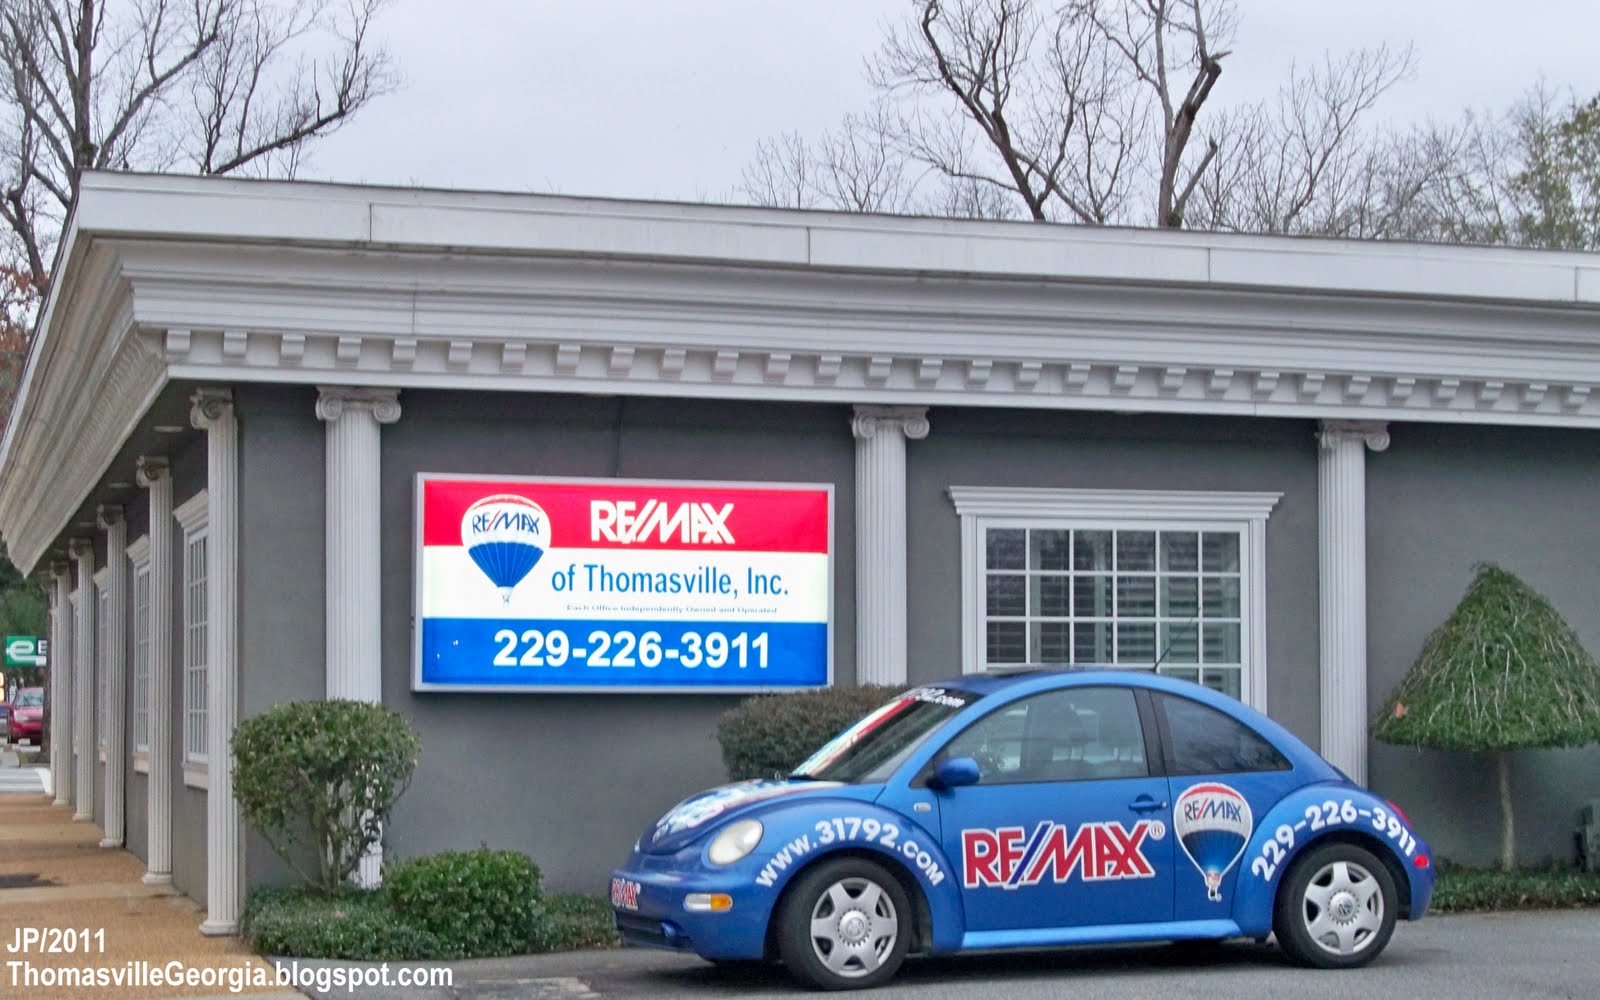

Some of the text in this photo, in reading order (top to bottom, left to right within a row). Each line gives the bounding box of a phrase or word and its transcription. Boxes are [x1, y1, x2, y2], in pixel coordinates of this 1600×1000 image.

[472, 510, 540, 536] RE/MAX
[590, 499, 735, 545] RE/MAX
[551, 564, 789, 600] of Thomasville, Inc.
[566, 603, 589, 611] Each
[620, 605, 683, 614] Independently
[737, 606, 778, 615] Operated
[493, 629, 769, 669] 229-226-3911
[1183, 798, 1242, 822] RE/MAX
[1252, 799, 1416, 882] 229-226-3911
